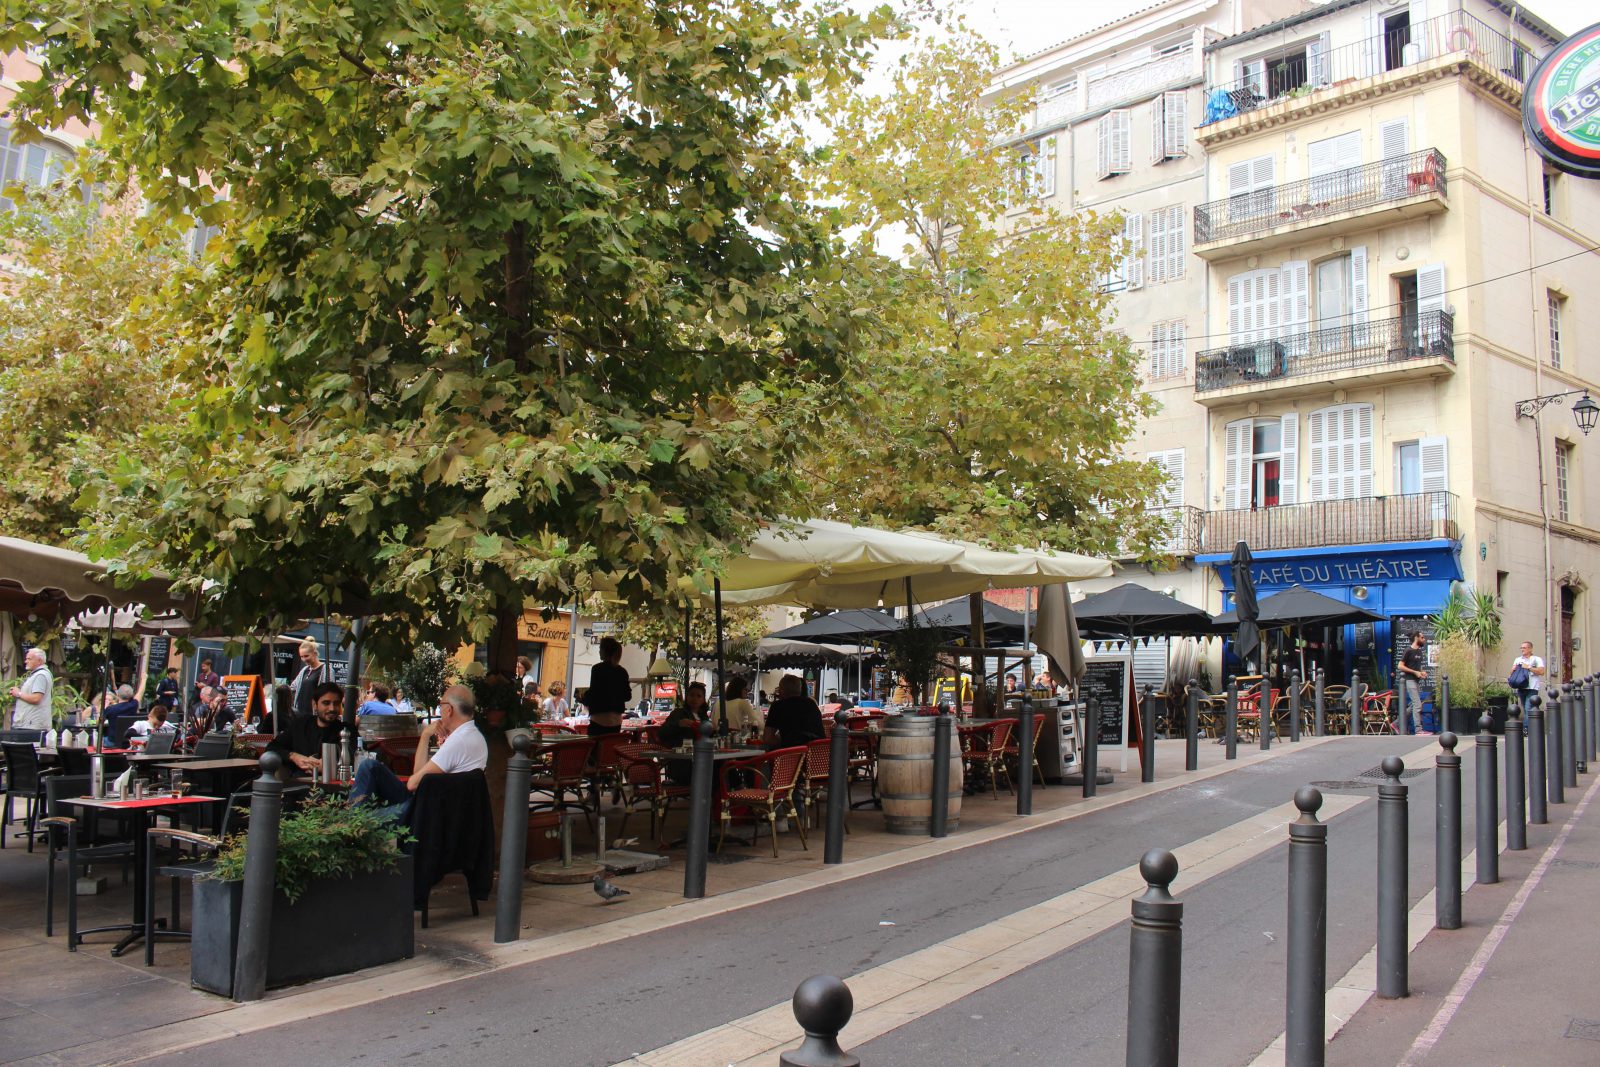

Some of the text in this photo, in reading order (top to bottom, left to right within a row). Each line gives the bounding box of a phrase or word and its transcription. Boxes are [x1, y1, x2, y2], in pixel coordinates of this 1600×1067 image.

[1556, 56, 1584, 87] BIERE
[1300, 565, 1331, 582] DU
[1335, 558, 1430, 581] THÉÂTRE
